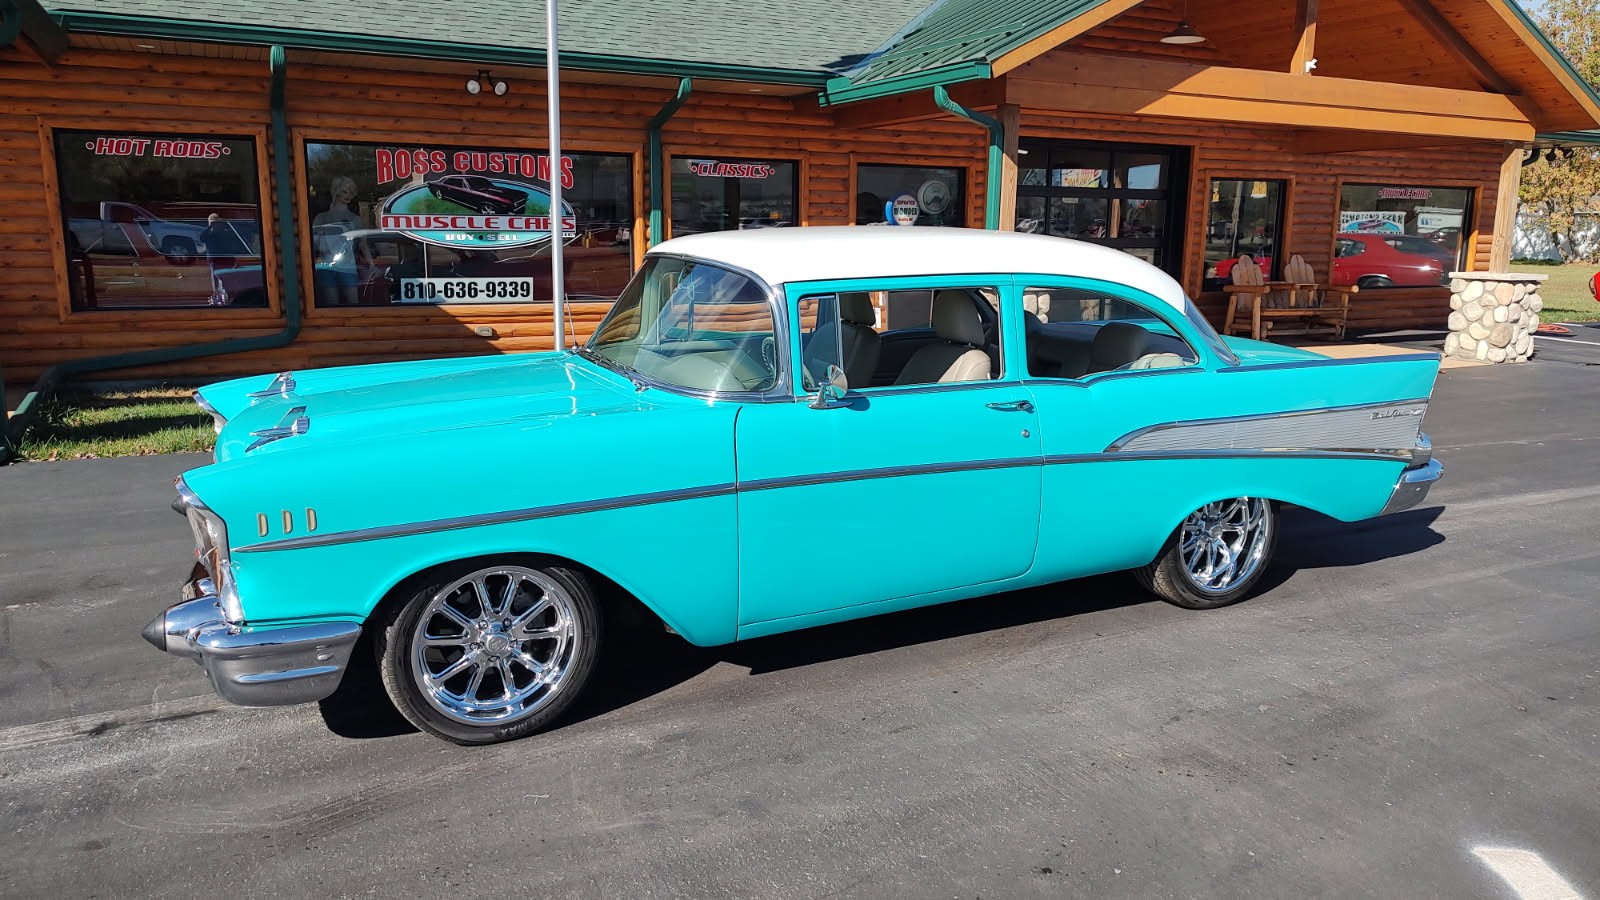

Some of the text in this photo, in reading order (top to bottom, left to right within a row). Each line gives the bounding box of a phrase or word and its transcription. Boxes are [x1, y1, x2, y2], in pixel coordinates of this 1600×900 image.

[95, 138, 222, 158] HOT RODS
[376, 149, 447, 184] ROSS
[697, 162, 770, 178] CLASSICS
[382, 215, 499, 229] MUSCLE
[445, 233, 520, 241] BUY SELL
[404, 281, 531, 299] 810-636-9339
